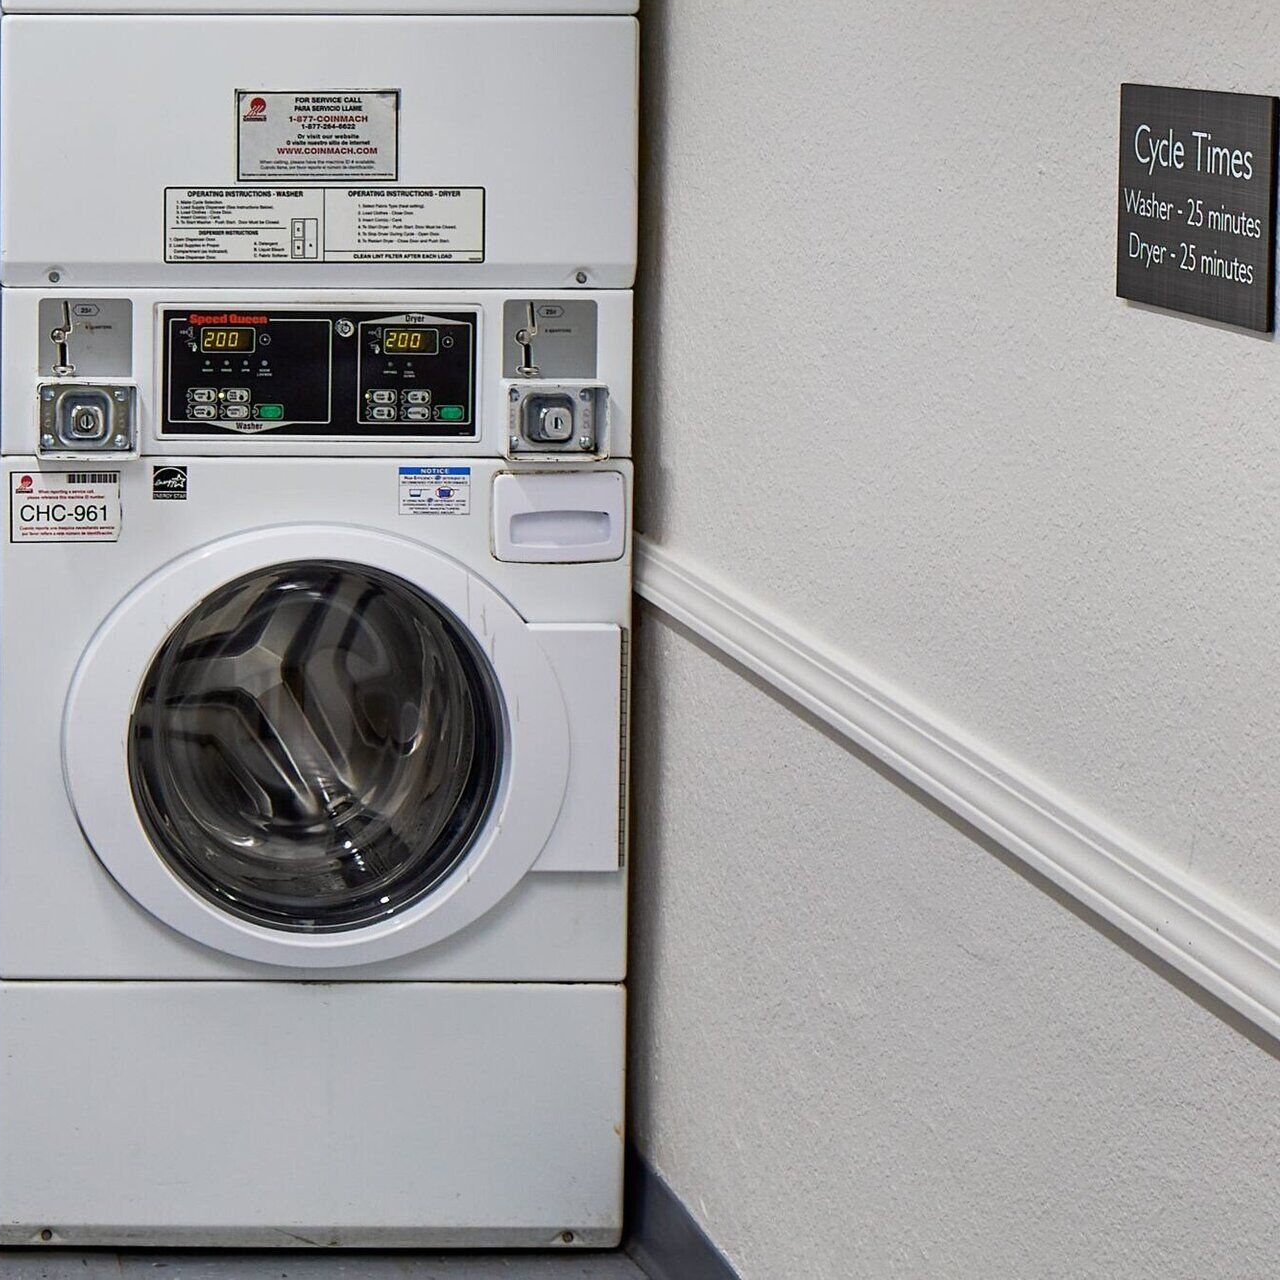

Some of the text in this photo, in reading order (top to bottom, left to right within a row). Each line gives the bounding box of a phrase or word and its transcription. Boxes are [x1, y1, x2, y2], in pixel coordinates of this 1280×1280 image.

[1134, 124, 1252, 180] Cycle Times
[1124, 188, 1173, 221] Washer
[1187, 199, 1203, 227] 25
[1208, 205, 1261, 239] minutes
[1129, 232, 1166, 268] Dryer
[1180, 242, 1196, 271] 25
[1201, 250, 1253, 285] minutes
[190, 314, 268, 325] Speed Queen
[405, 315, 425, 323] Dryer
[204, 332, 239, 347] 200
[386, 333, 421, 348] 200
[20, 504, 107, 522] CHC-961
